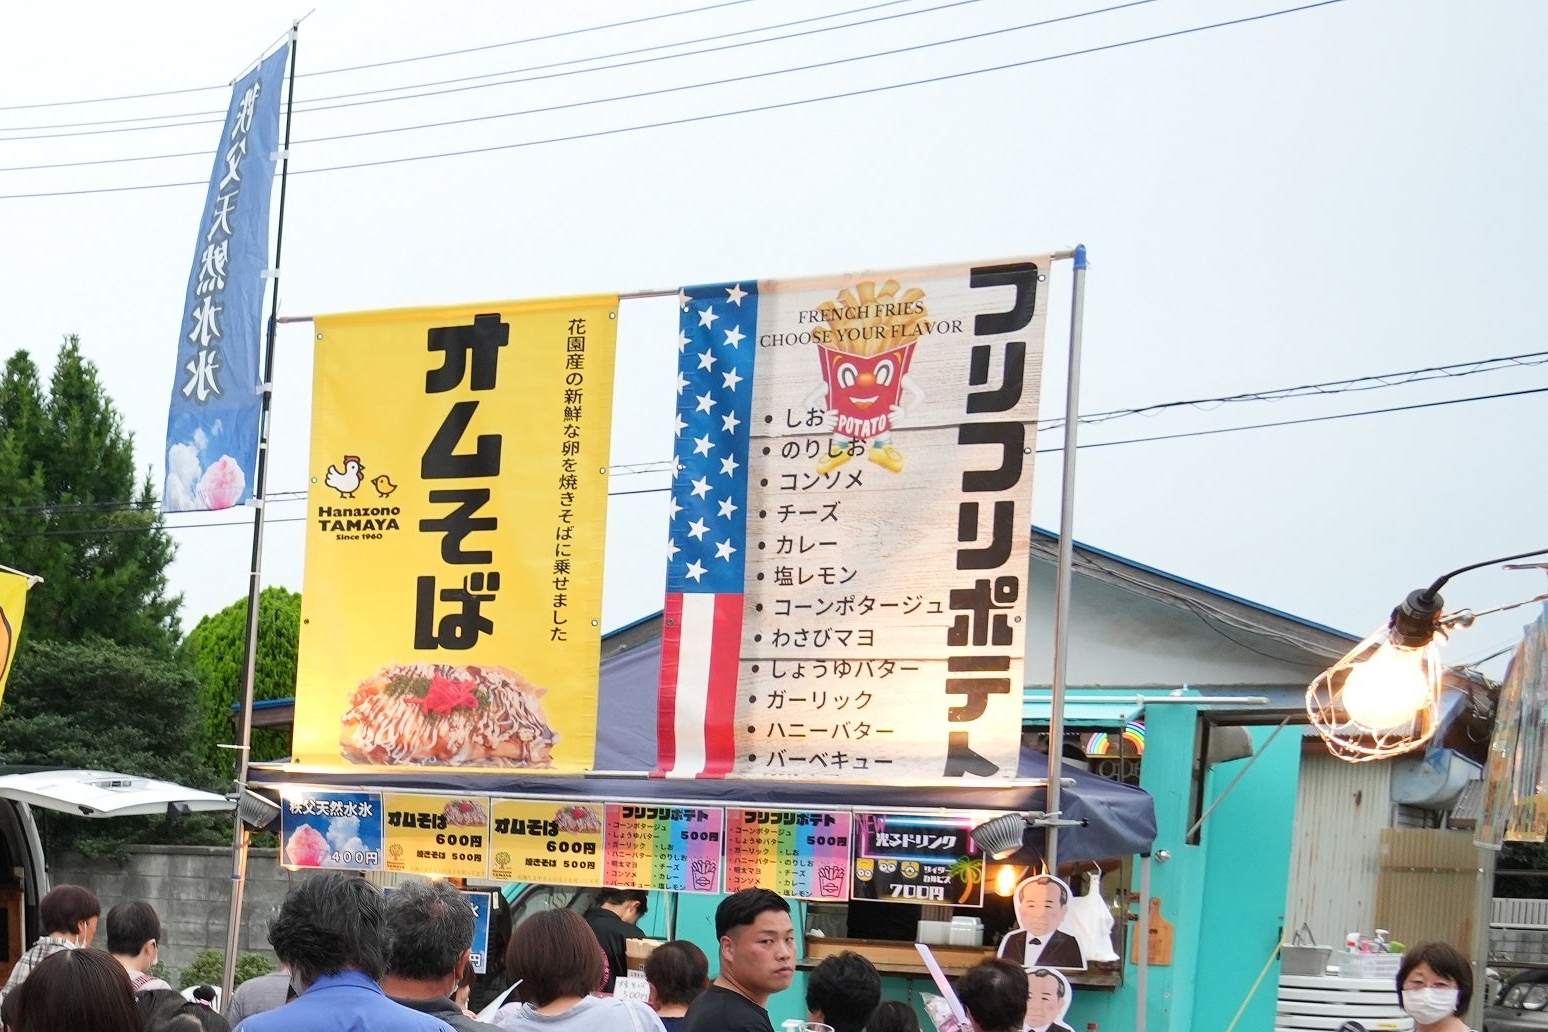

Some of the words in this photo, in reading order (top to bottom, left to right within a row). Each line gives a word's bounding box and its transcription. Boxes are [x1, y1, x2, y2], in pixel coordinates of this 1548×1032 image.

[799, 306, 869, 323] FRENCH
[875, 301, 924, 317] FRIES
[760, 330, 832, 347] CHOOSE
[838, 326, 885, 342] YOUR
[891, 320, 963, 339] FLAVOR
[787, 408, 825, 428] しお
[838, 414, 886, 437] POTATO
[781, 437, 866, 459] のりしお
[414, 312, 511, 652] オムそば
[550, 319, 586, 642] 花園産の新鮮な卵を焼きそばに乗せました
[780, 470, 863, 490] コンソメ
[318, 507, 400, 517] Hanazono
[777, 501, 840, 523] チーズ
[318, 519, 400, 531] TAMAYA
[944, 262, 1038, 778] フリフリポテト
[777, 535, 837, 554] カレー
[774, 566, 857, 586] 塩レモン
[775, 595, 943, 616] コーンポタージュ
[772, 628, 874, 647] わさびマヨ
[772, 659, 919, 679] しょうゆバター
[767, 690, 873, 710] ガーリック
[767, 721, 894, 740] ハニーバター
[766, 749, 893, 769] バーベキュー
[289, 800, 373, 817] 秩父天然水氷
[622, 807, 709, 822] フリフリポテト
[745, 811, 835, 827] フリフリポテト
[613, 822, 667, 831] コーンポタージュ
[734, 827, 792, 836] コーンポタージュ
[436, 834, 482, 847] 600円
[613, 832, 660, 840] しょうゆバター
[680, 831, 718, 842] 500円
[734, 837, 784, 845] しょうゆバター
[806, 836, 847, 846] 500円
[876, 832, 957, 849] 光るドリンク
[547, 841, 596, 854] 600円
[612, 841, 645, 849] ガーリック
[660, 843, 674, 851] しお
[734, 847, 769, 855] ガーリック
[331, 851, 379, 864] 400円
[452, 852, 482, 862] 500円
[611, 851, 652, 859] ハニーバター
[659, 853, 688, 861] のりしお
[733, 857, 777, 865] ハニーバター
[564, 860, 595, 870] 500円
[611, 860, 638, 869] 明太マヨ
[659, 862, 680, 871] チーズ
[784, 859, 814, 867] のりしお
[611, 870, 637, 878] コンソメ
[733, 866, 762, 874] 明太マヨ
[785, 868, 806, 877] チーズ
[658, 882, 686, 890] 塩レモン
[733, 876, 761, 884] コンソメ
[784, 879, 805, 887] カレー
[783, 888, 813, 897] 塩レモン
[890, 884, 945, 901] 700円
